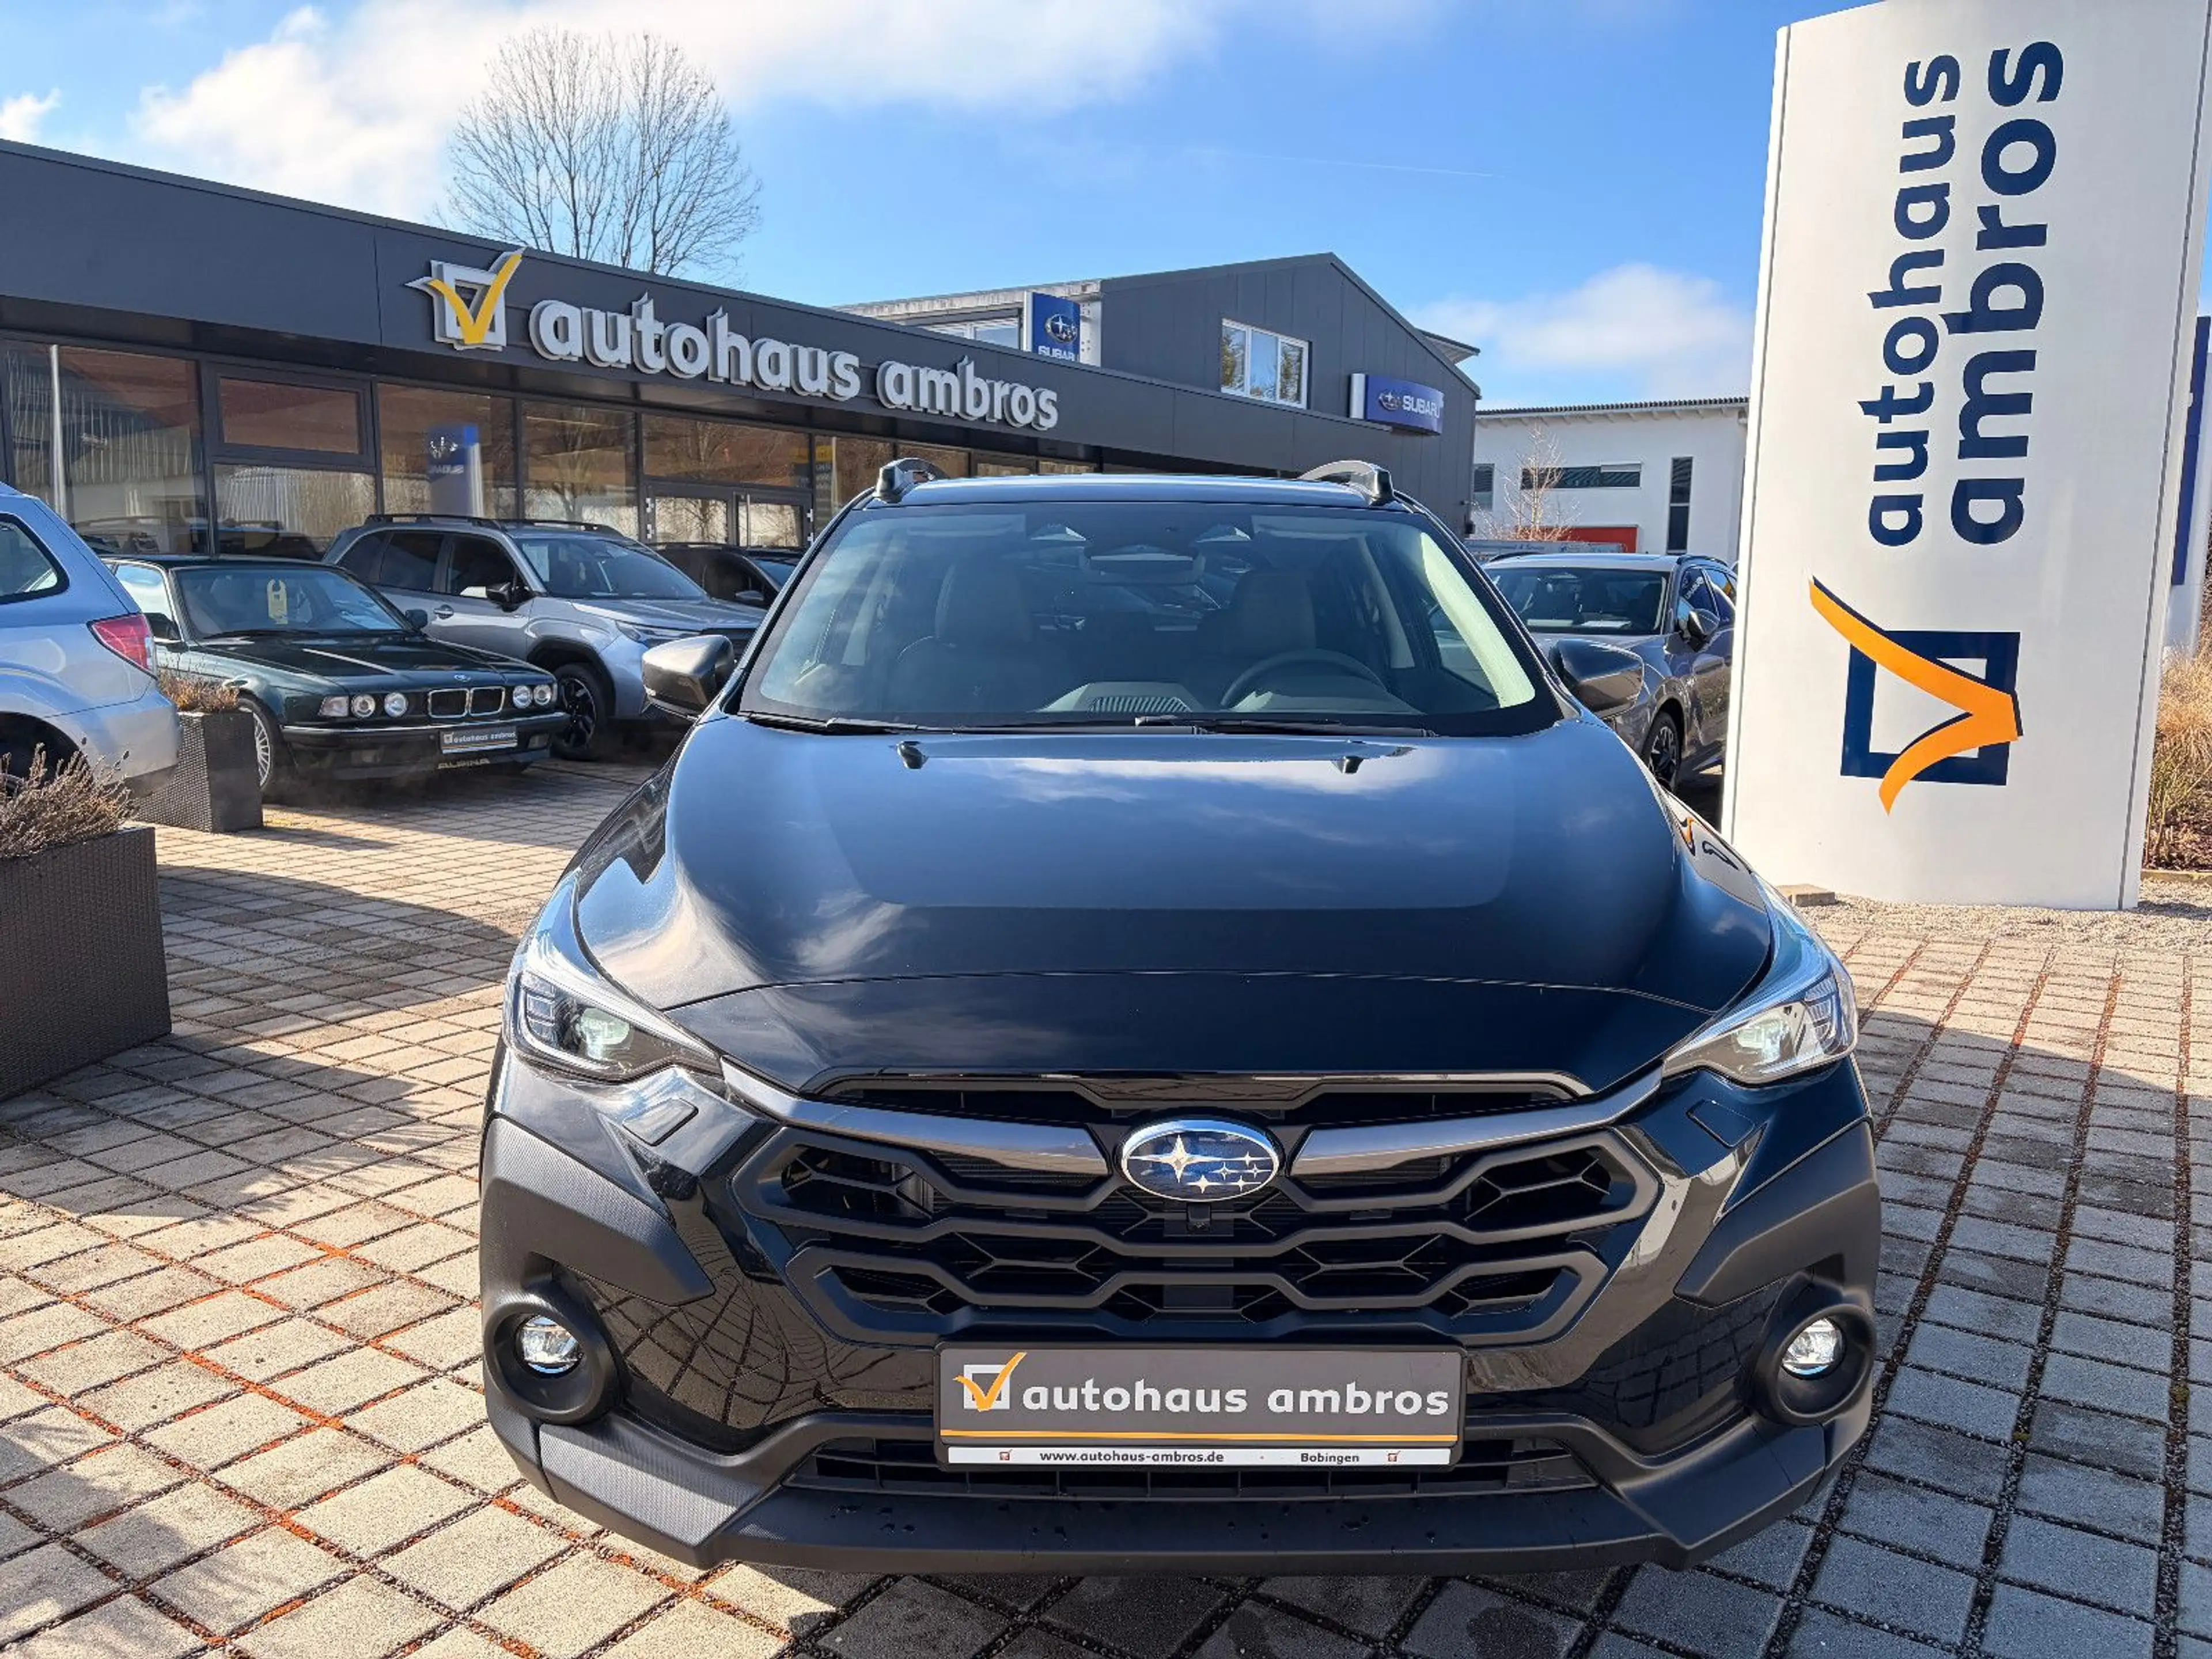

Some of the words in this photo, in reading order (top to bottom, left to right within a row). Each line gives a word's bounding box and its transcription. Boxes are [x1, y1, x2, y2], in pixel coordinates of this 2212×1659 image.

[1857, 54, 1961, 547] autohaus
[1939, 40, 2064, 546] ambros
[528, 291, 862, 402] autohaus
[876, 354, 1059, 431] ambros
[1402, 395, 1441, 418] SUBARU
[1022, 1377, 1248, 1413] autohaus
[1268, 1381, 1449, 1415] ambros
[1040, 1450, 1225, 1464] www.autohaus-ambros.de
[1300, 1452, 1360, 1465] Bobingen
